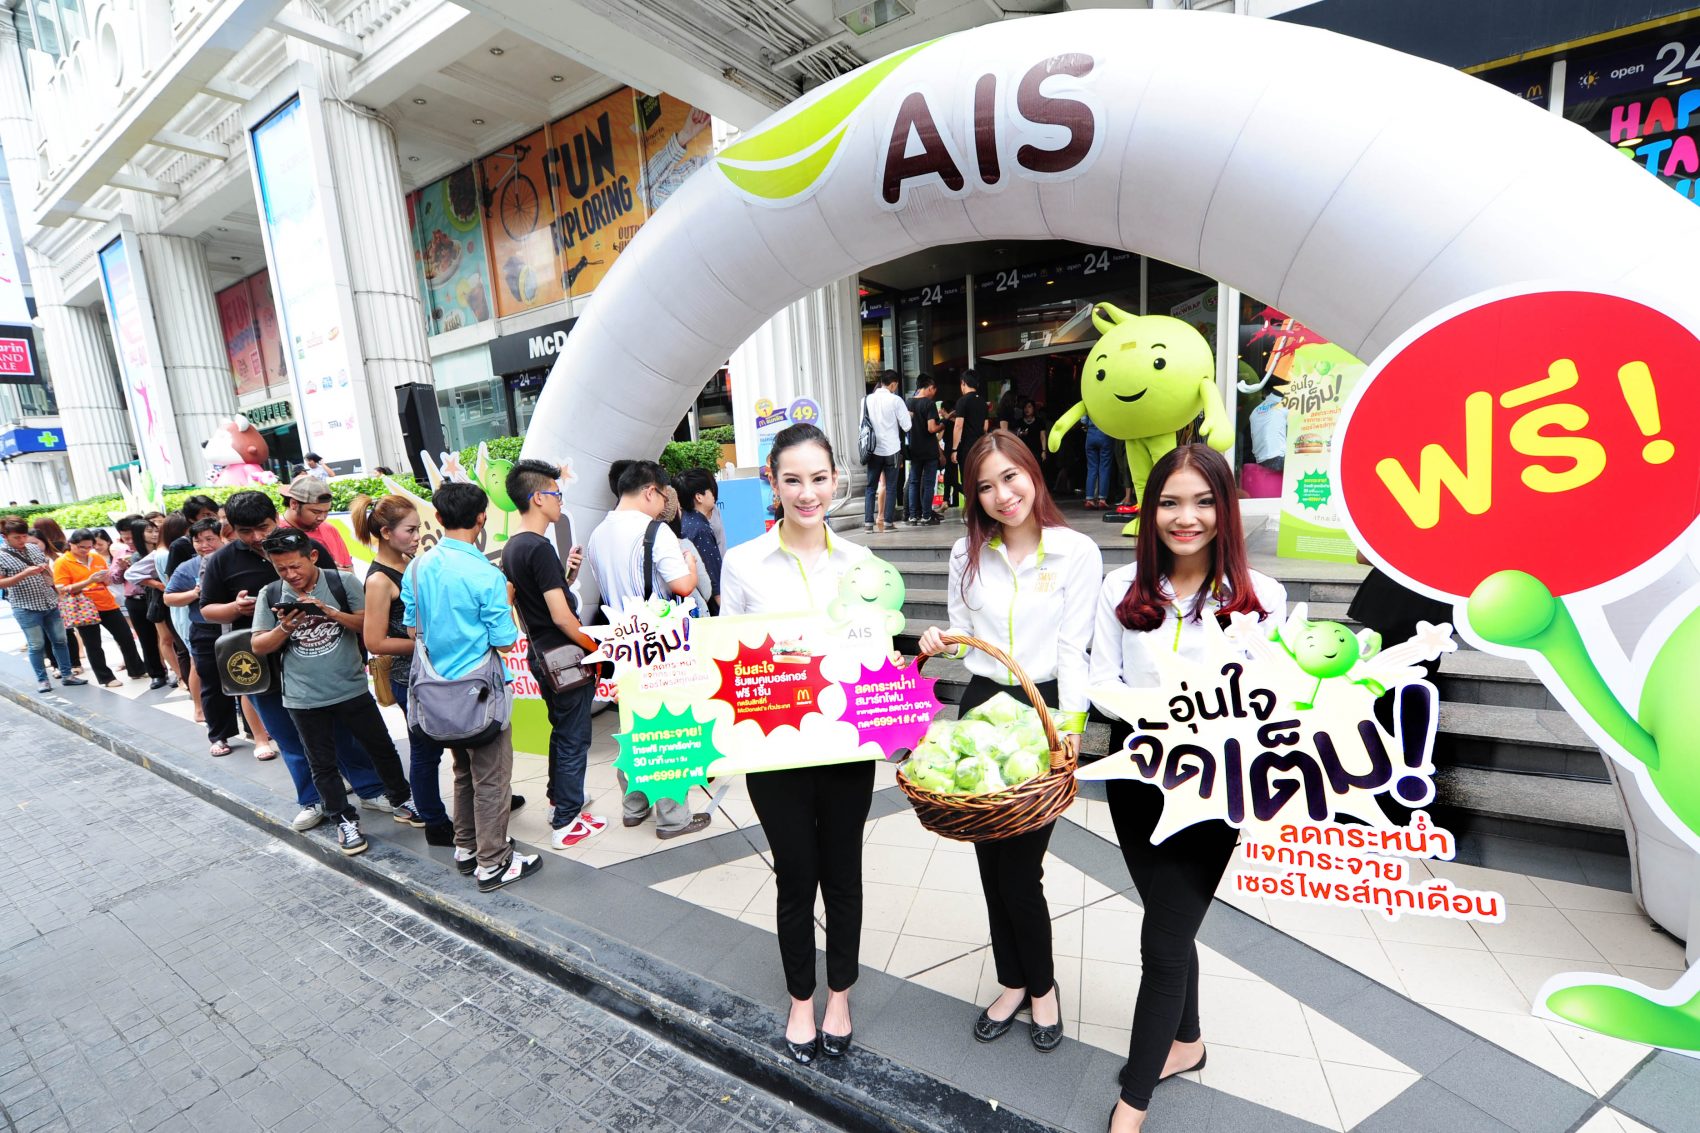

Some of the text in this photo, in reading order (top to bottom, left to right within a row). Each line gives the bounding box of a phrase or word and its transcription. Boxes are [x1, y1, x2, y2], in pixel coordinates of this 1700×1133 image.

[1611, 63, 1645, 80] open
[883, 52, 1097, 205] AIS
[542, 111, 616, 213] FUN
[1066, 251, 1130, 275] open 24 hours
[981, 280, 994, 289] open
[996, 269, 1020, 292] 24
[921, 285, 943, 306] 24
[519, 373, 530, 387] 24
[1291, 374, 1314, 394] อุ่นใจ
[246, 401, 288, 424] COFFEE
[615, 615, 649, 640] อุ่นใจ
[848, 627, 873, 639] AIS
[601, 617, 691, 668] จัดเต็ม!
[734, 660, 775, 676] อิ่มสะใจ
[736, 687, 751, 698] ฟรี
[1168, 662, 1277, 735] อุ่นใจ
[917, 712, 930, 722] ฟรี
[633, 757, 646, 767] 30
[648, 755, 663, 766] นาที
[1129, 683, 1431, 823] จัดเต็ม!
[690, 766, 704, 777] ฟรี
[1280, 817, 1448, 855] ลดกระหน่ำ
[1245, 841, 1402, 882] แจกกระจาย
[1237, 873, 1498, 916] เซอร์ไพรส์ทุกเดือน
